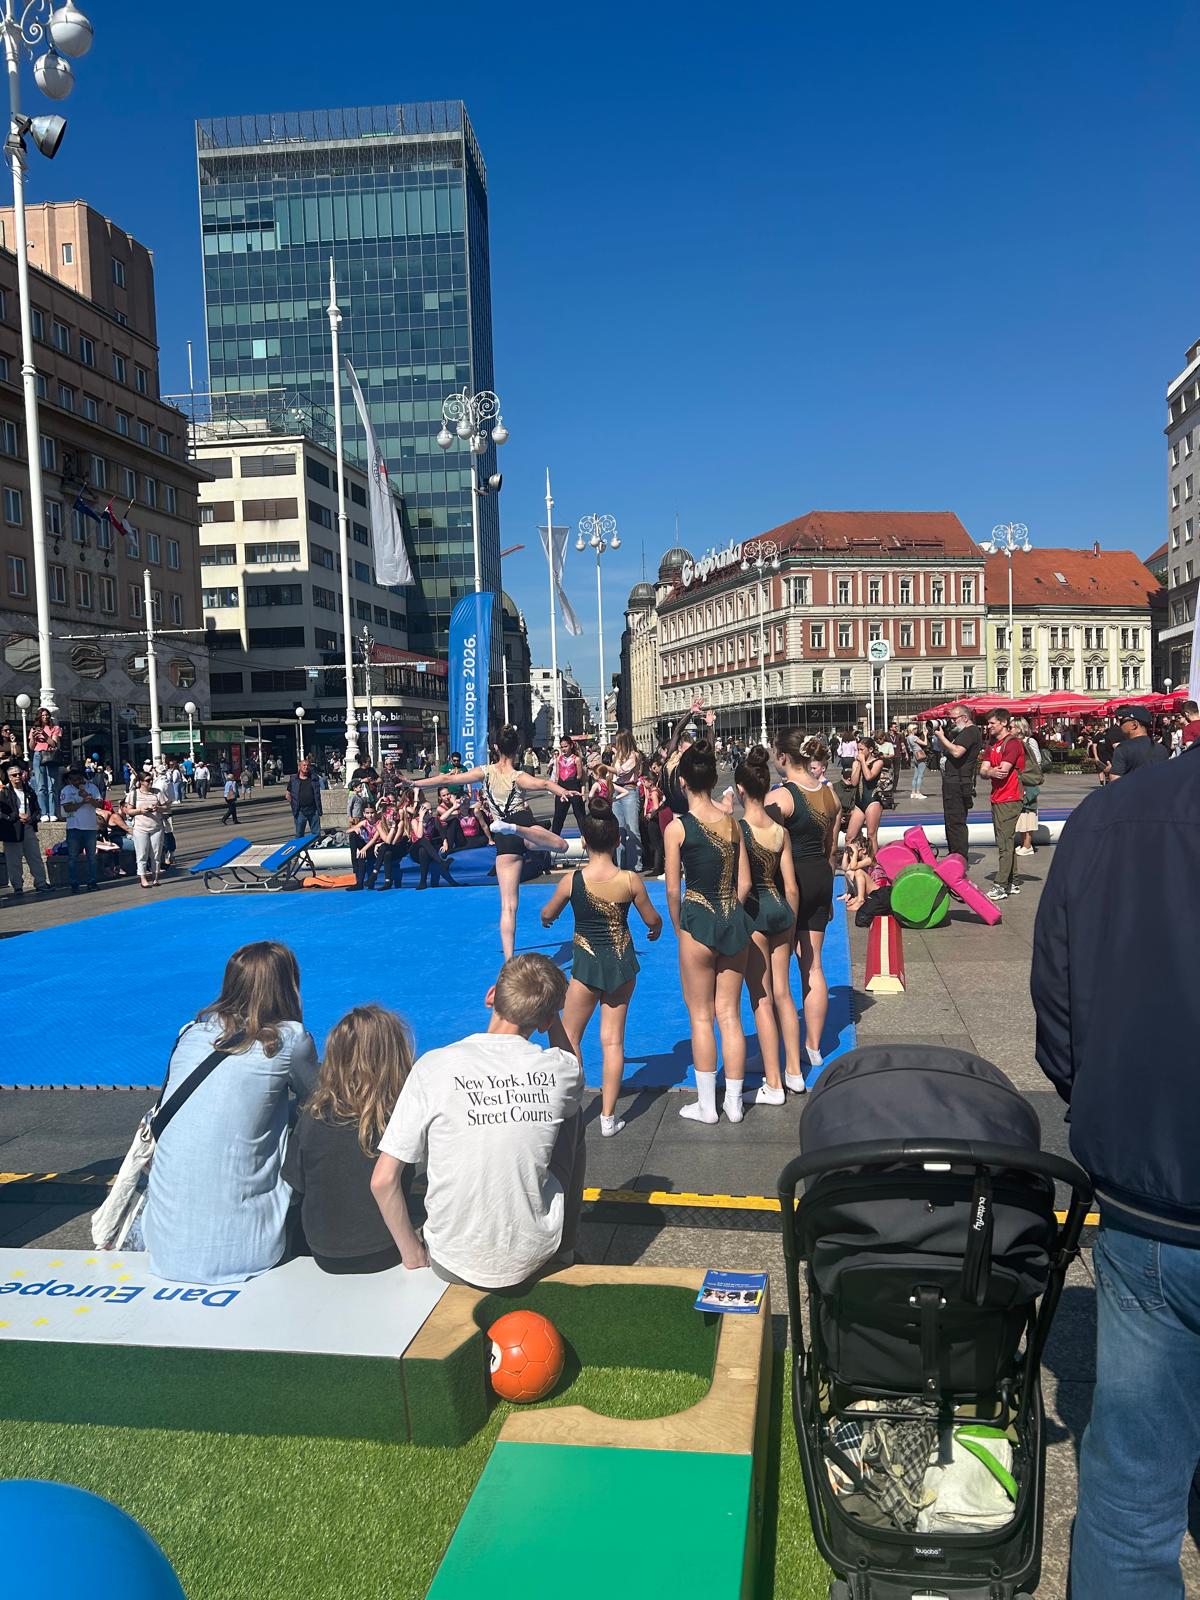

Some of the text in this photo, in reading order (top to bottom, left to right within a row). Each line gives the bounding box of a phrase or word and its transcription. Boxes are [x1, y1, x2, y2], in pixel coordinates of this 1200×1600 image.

[463, 634, 477, 771] Dan Europe 2026.
[321, 714, 338, 722] Kad
[454, 1071, 557, 1091] New York, 1624
[467, 1089, 550, 1106] West Fourth
[467, 1106, 553, 1126] Street Courts
[973, 1196, 986, 1231] butterfly
[0, 1279, 242, 1307] Dan Europe
